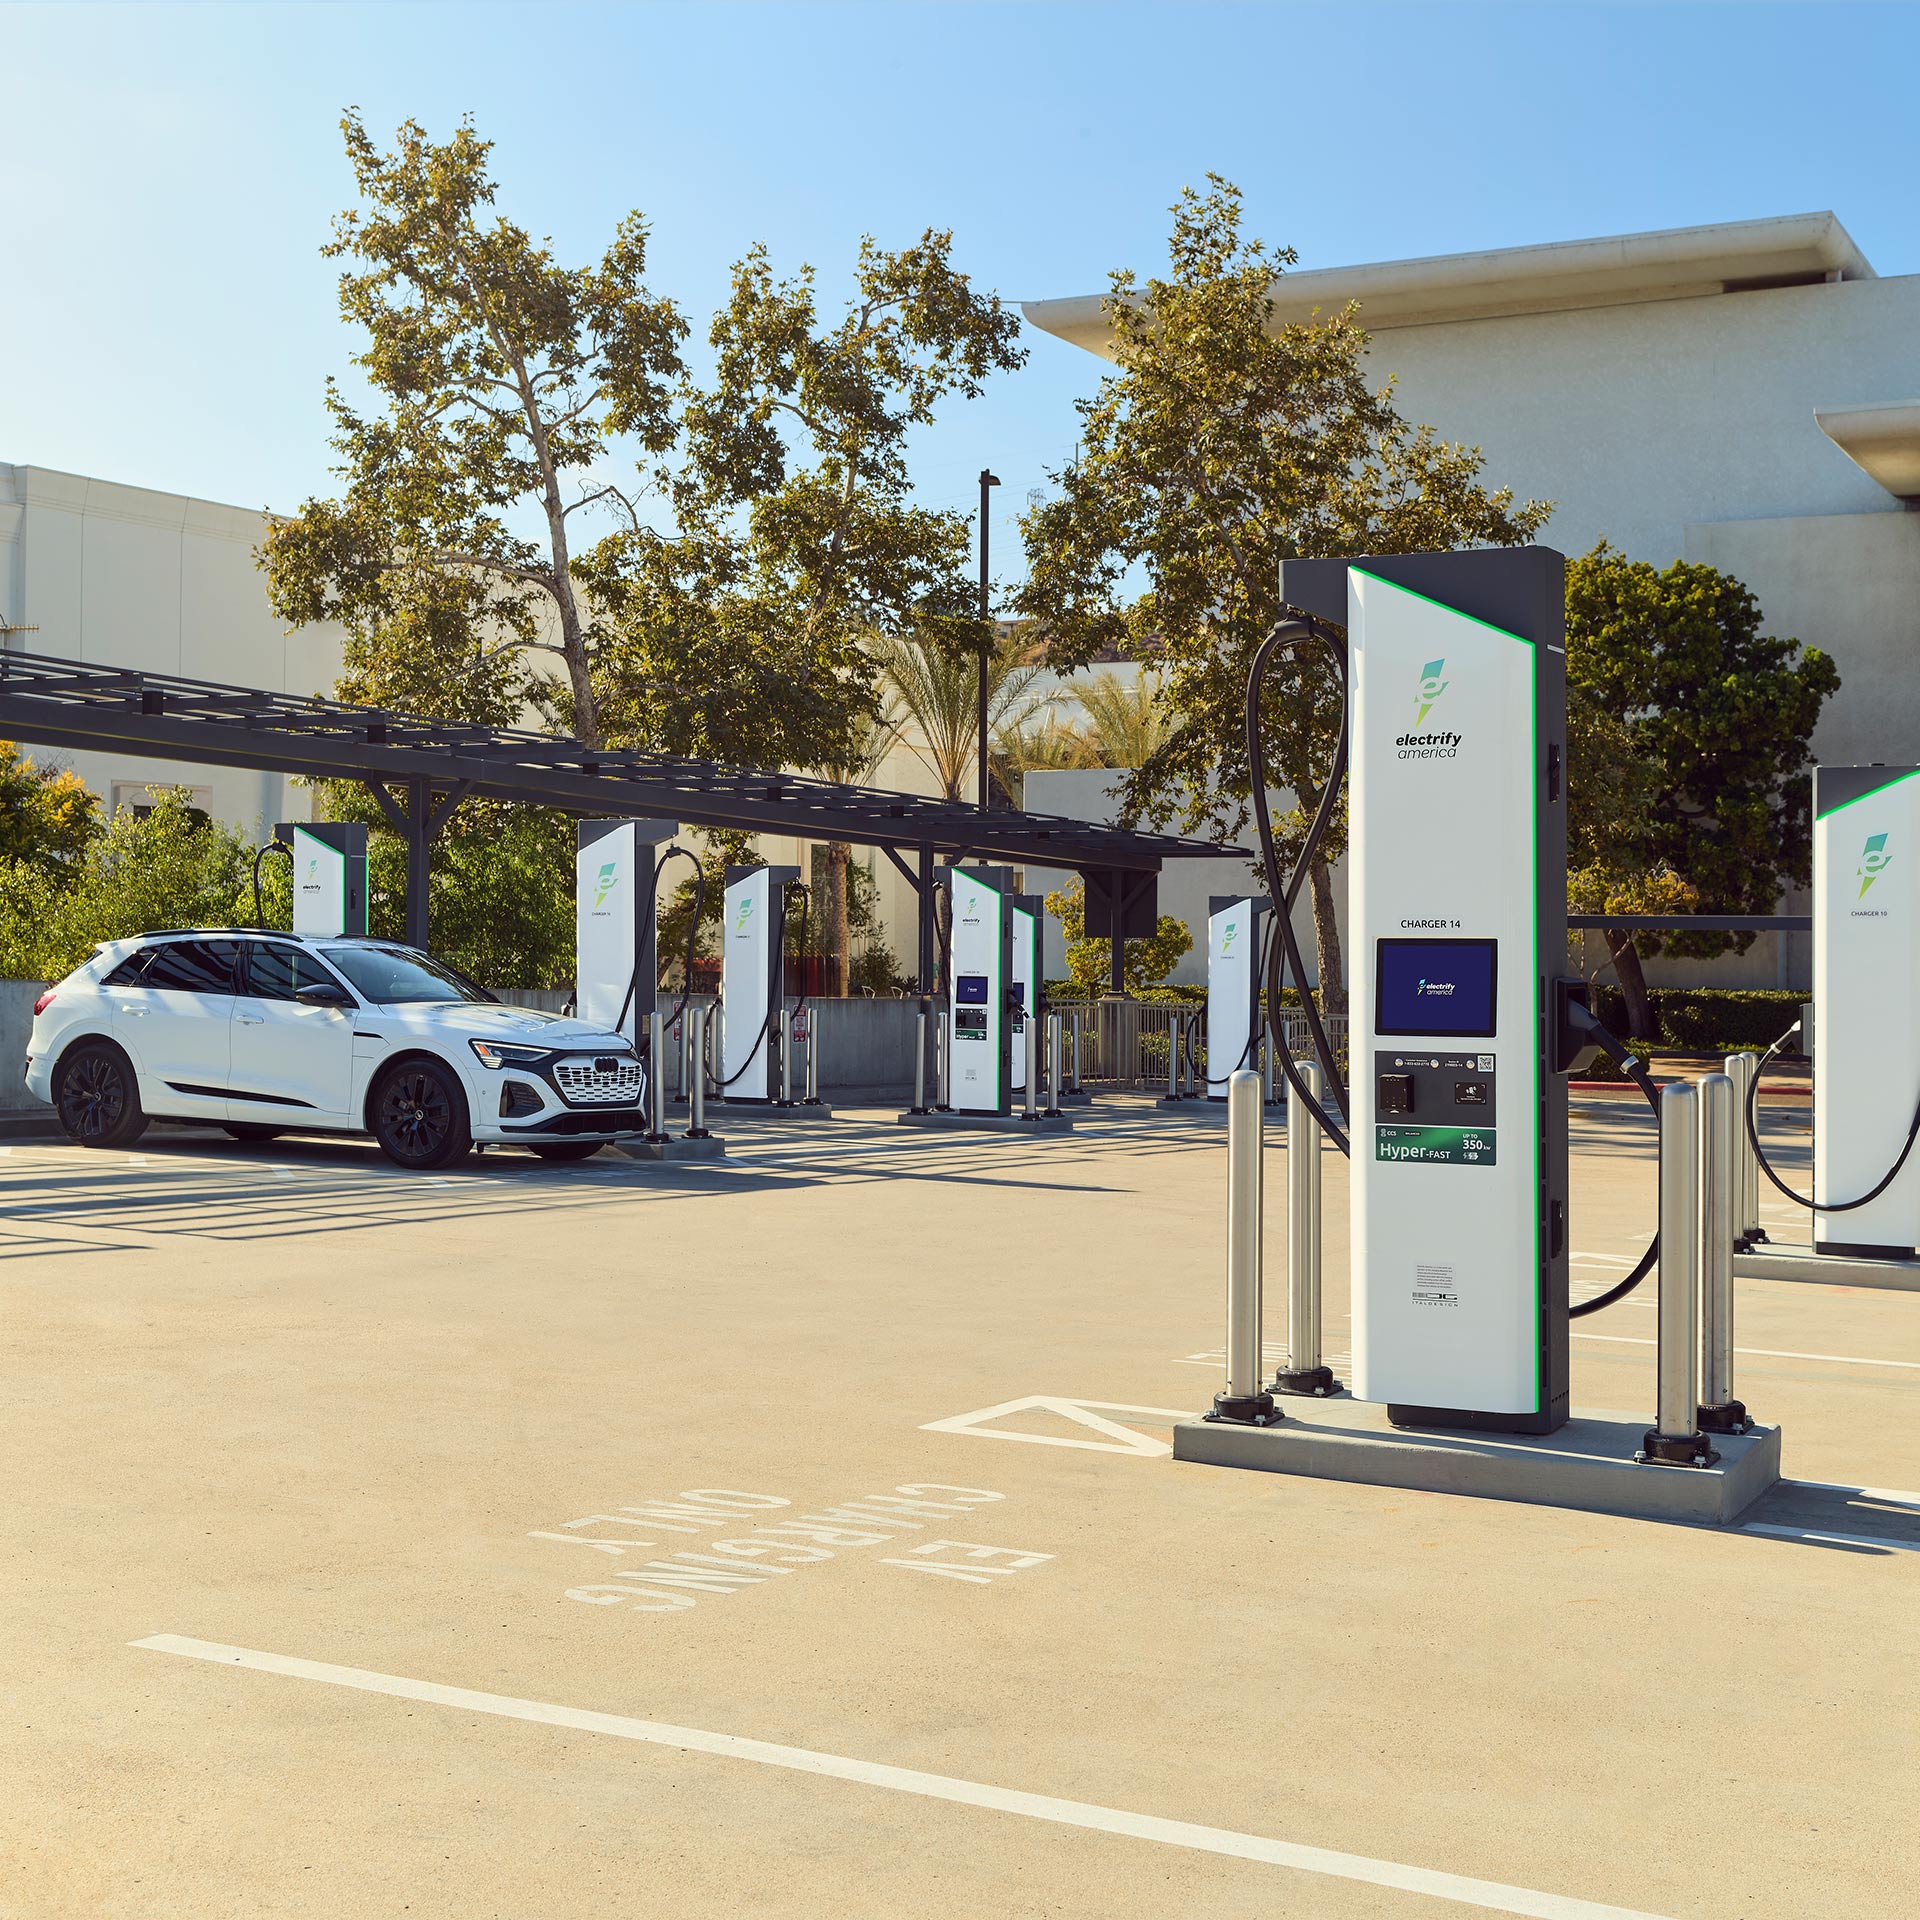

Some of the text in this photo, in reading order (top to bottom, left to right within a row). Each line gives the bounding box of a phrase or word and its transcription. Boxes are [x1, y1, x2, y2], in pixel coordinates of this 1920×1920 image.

[1396, 732, 1462, 747] electrify
[1398, 746, 1457, 760] america
[1400, 920, 1461, 928] CHARGER 14
[1462, 1140, 1483, 1150] 350
[525, 1488, 792, 1556] ONLY
[564, 1482, 1007, 1613] CHARGING
[877, 1538, 1058, 1584] EV
